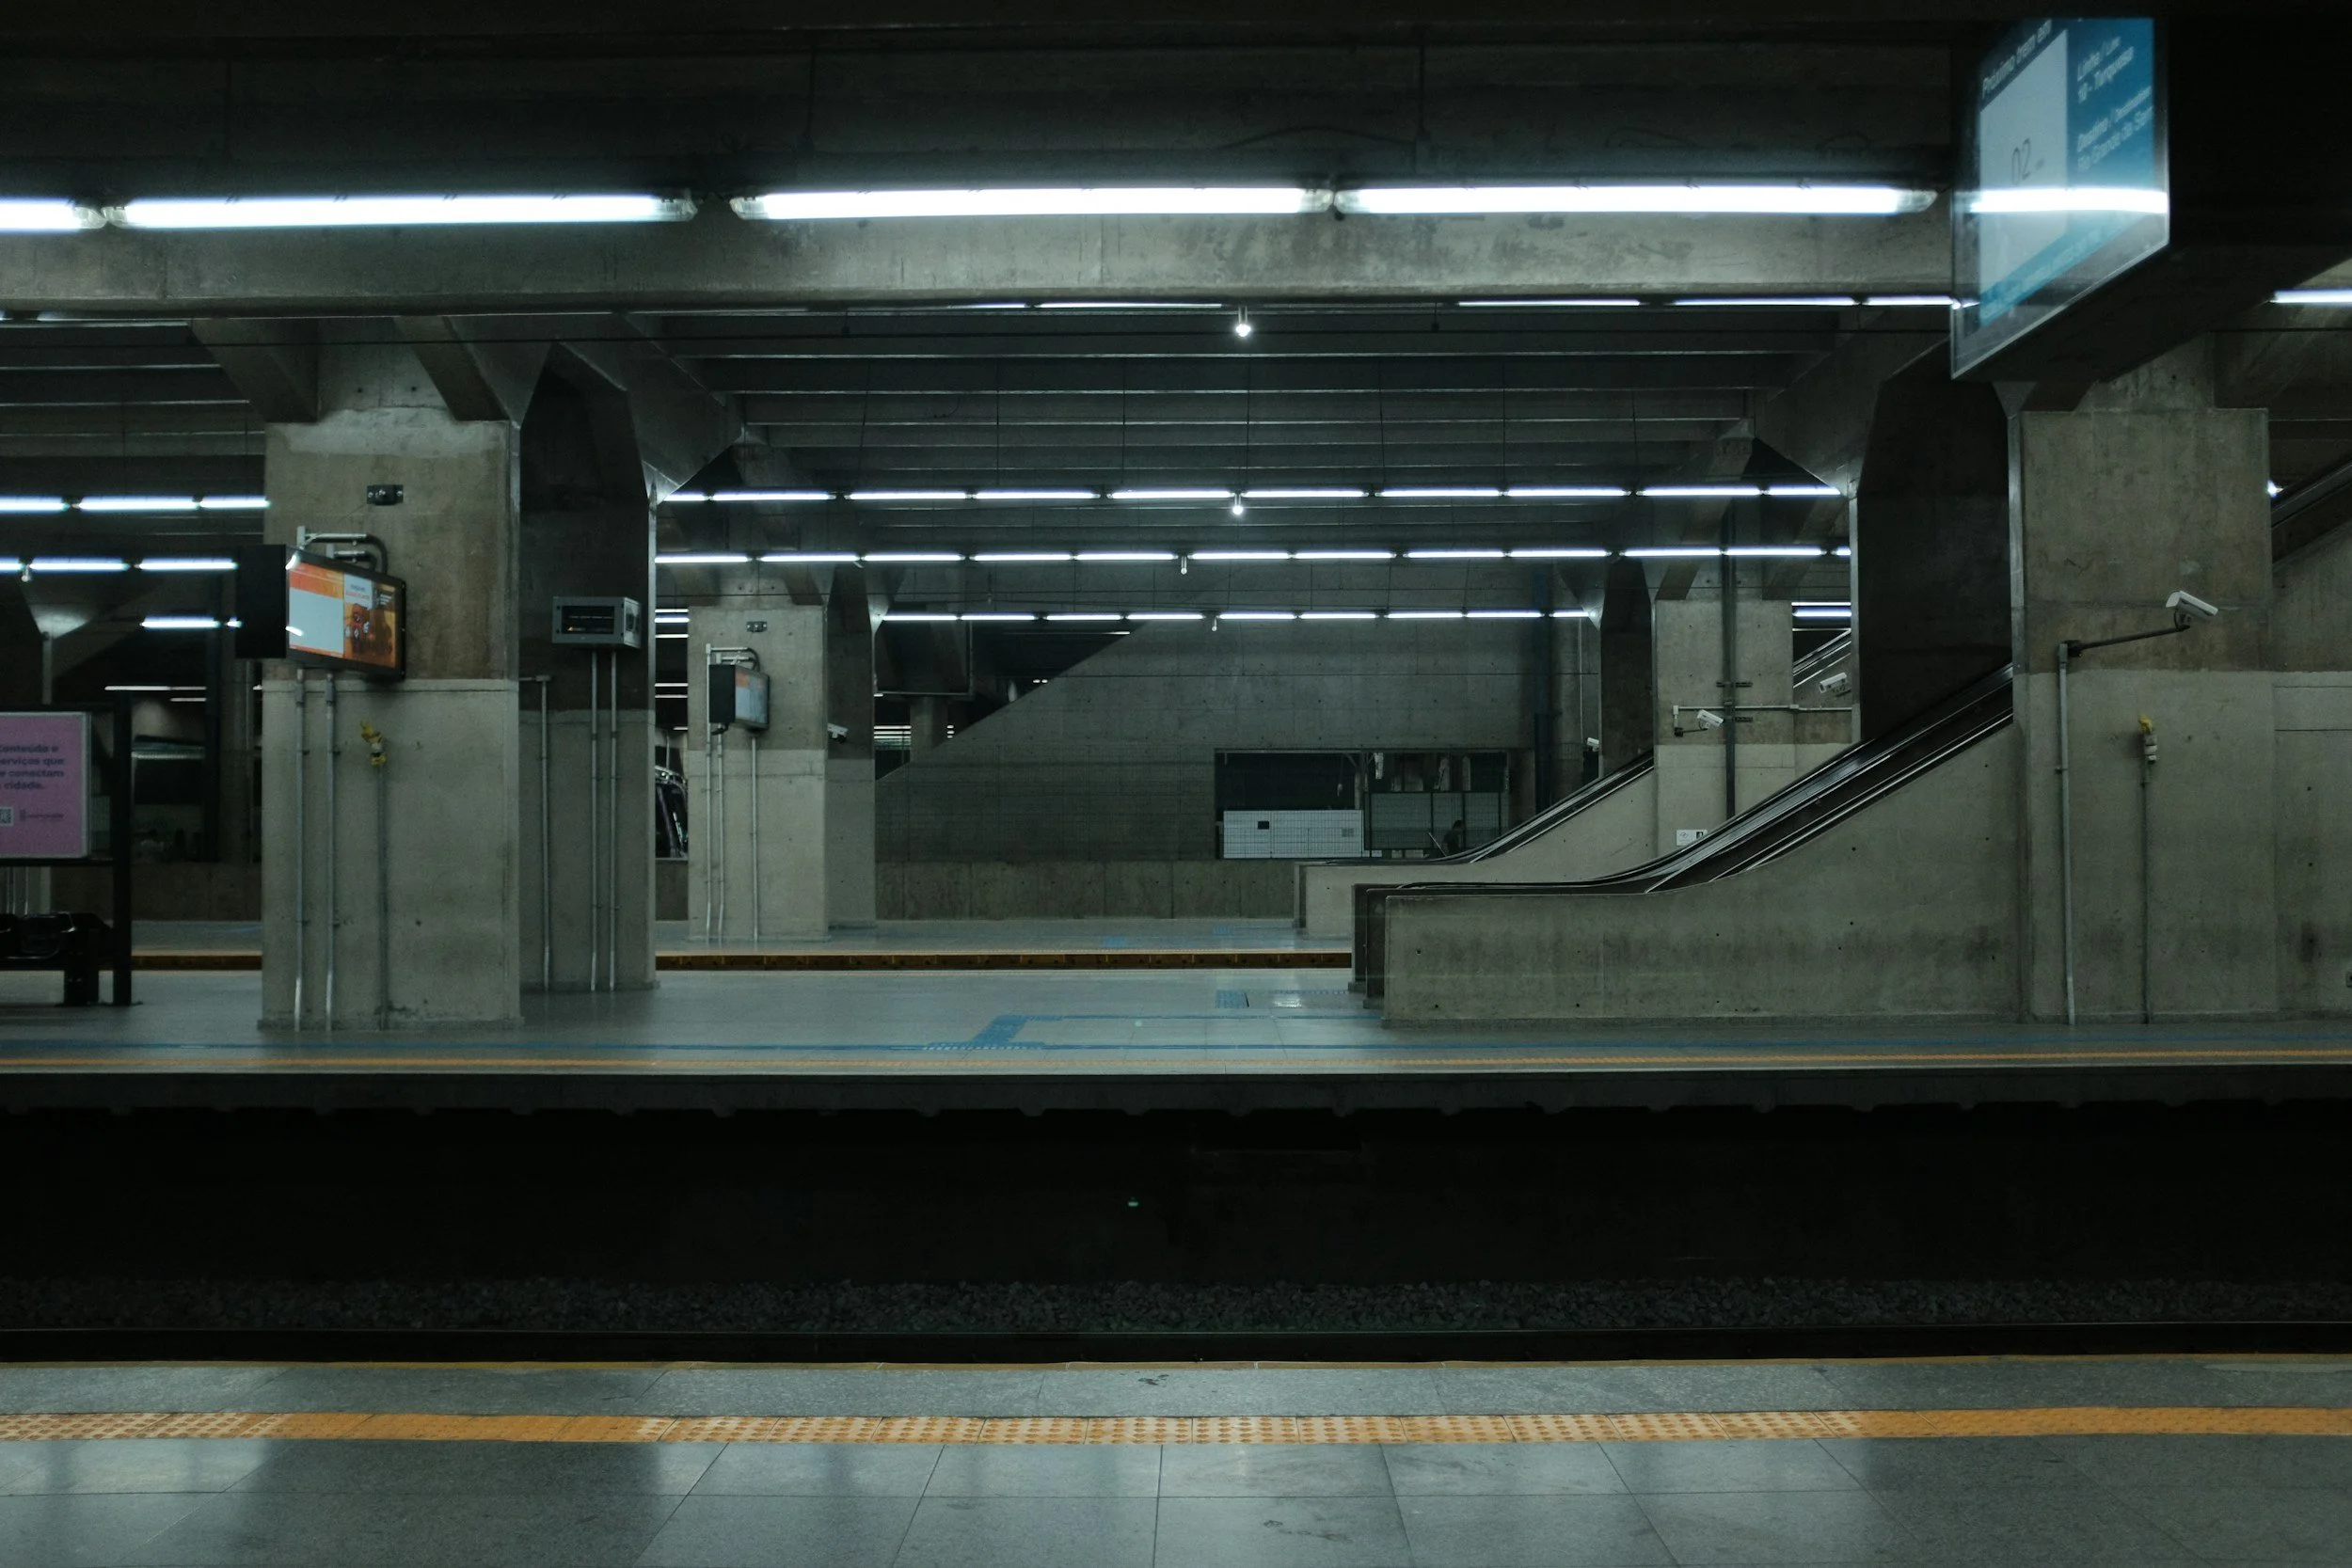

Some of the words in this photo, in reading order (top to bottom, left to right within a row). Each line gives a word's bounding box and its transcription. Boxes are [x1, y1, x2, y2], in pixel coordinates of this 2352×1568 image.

[2011, 138, 2031, 185] 02
[0, 756, 40, 766] erviços
[43, 757, 64, 767] que
[8, 768, 64, 777] conectam
